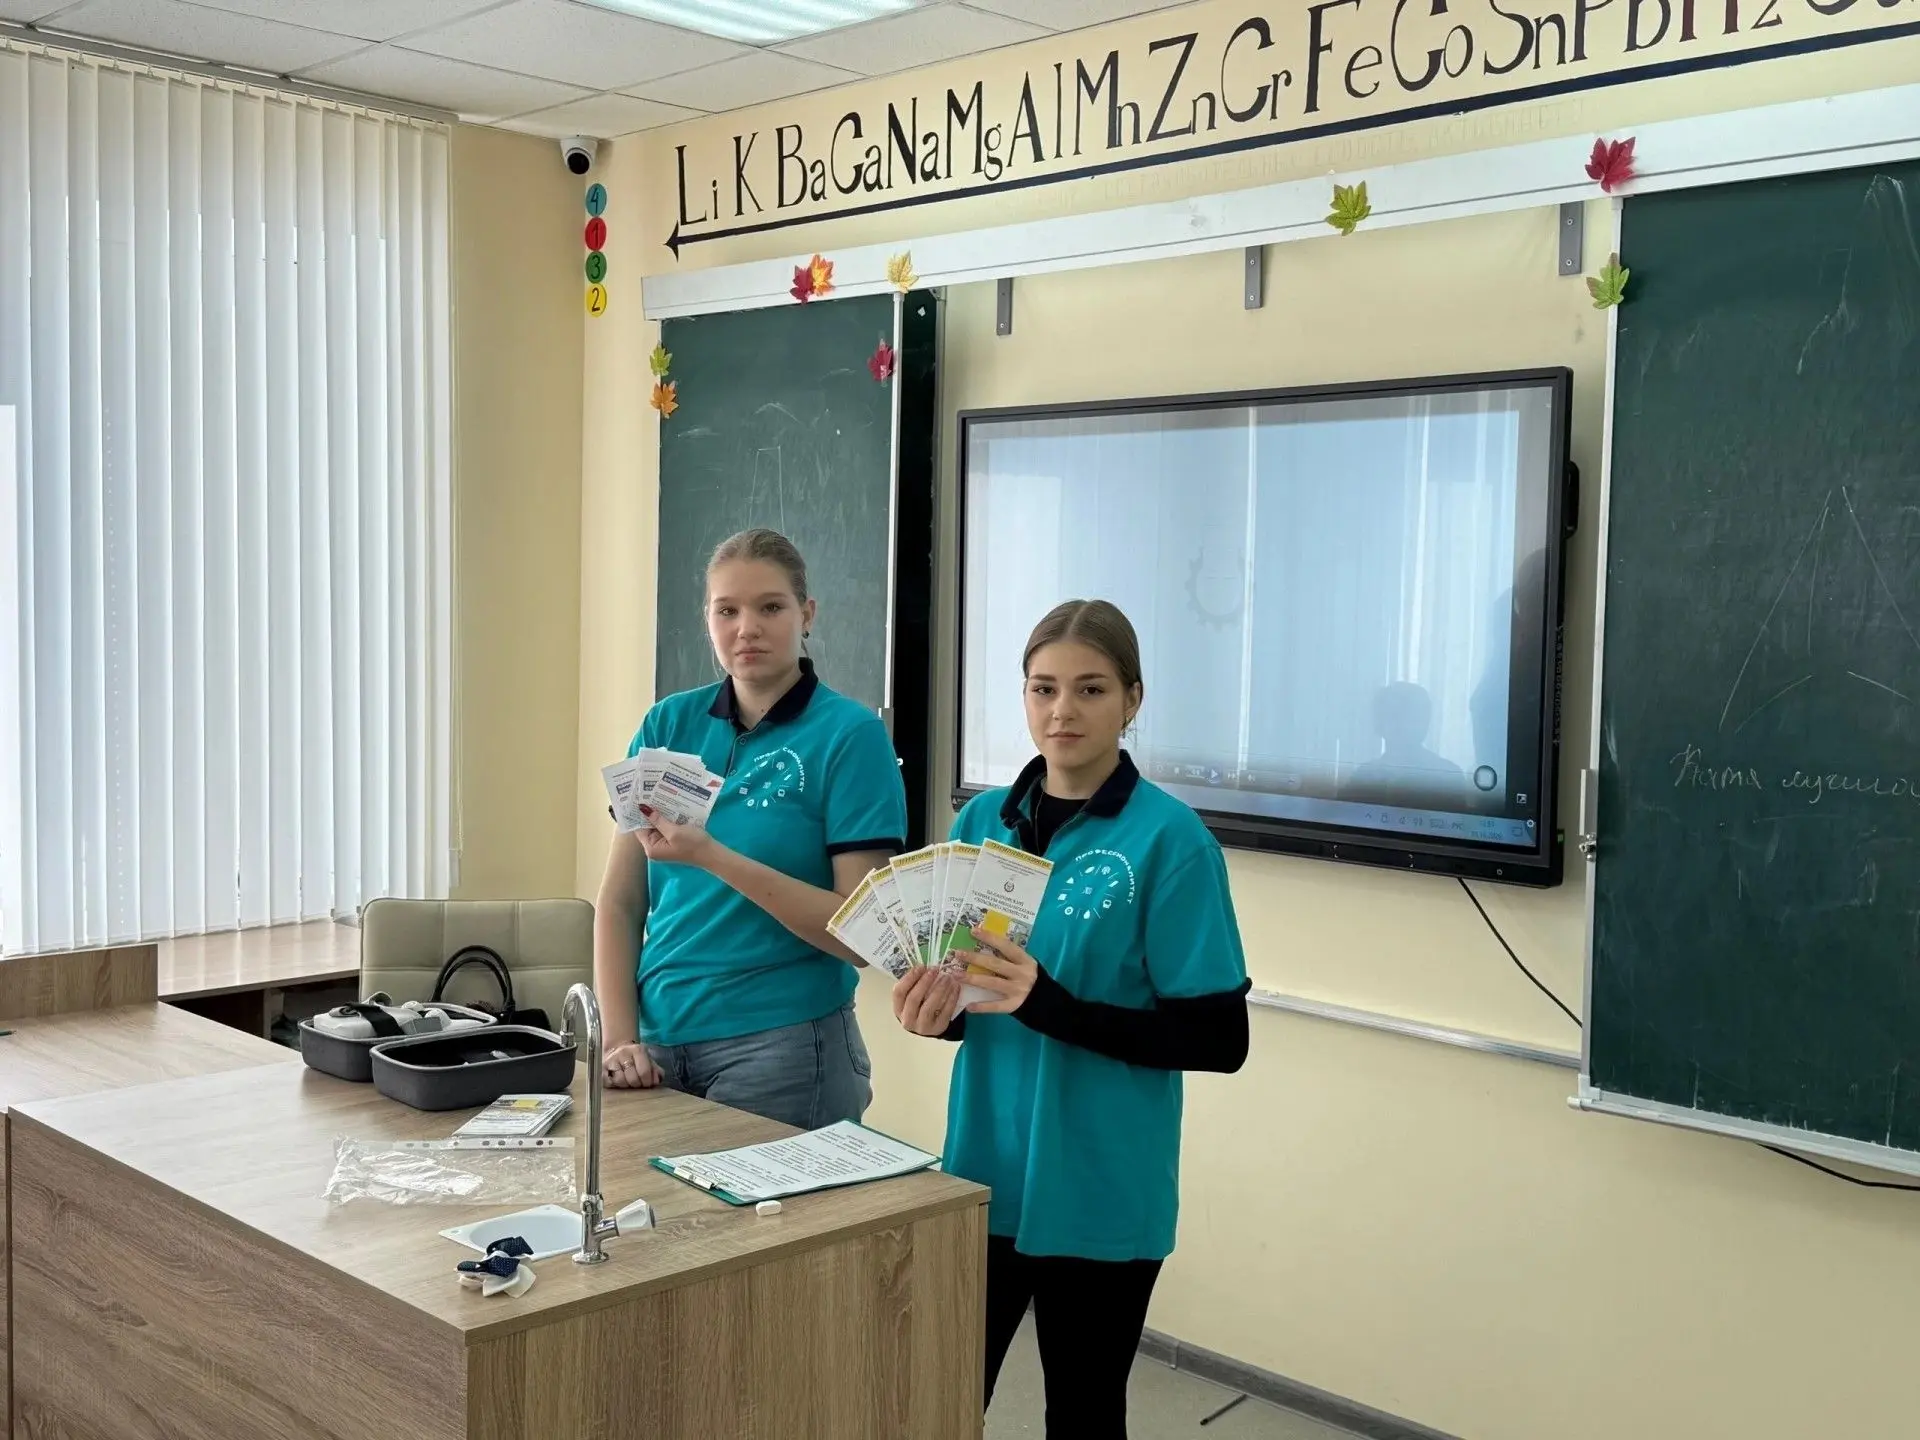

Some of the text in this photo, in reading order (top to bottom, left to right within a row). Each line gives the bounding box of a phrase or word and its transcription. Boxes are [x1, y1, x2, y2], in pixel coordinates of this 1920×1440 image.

[590, 254, 601, 280] 3
[591, 287, 600, 312] 2
[1075, 849, 1136, 905] ПРОФЕССИОНАЛИТЕТ
